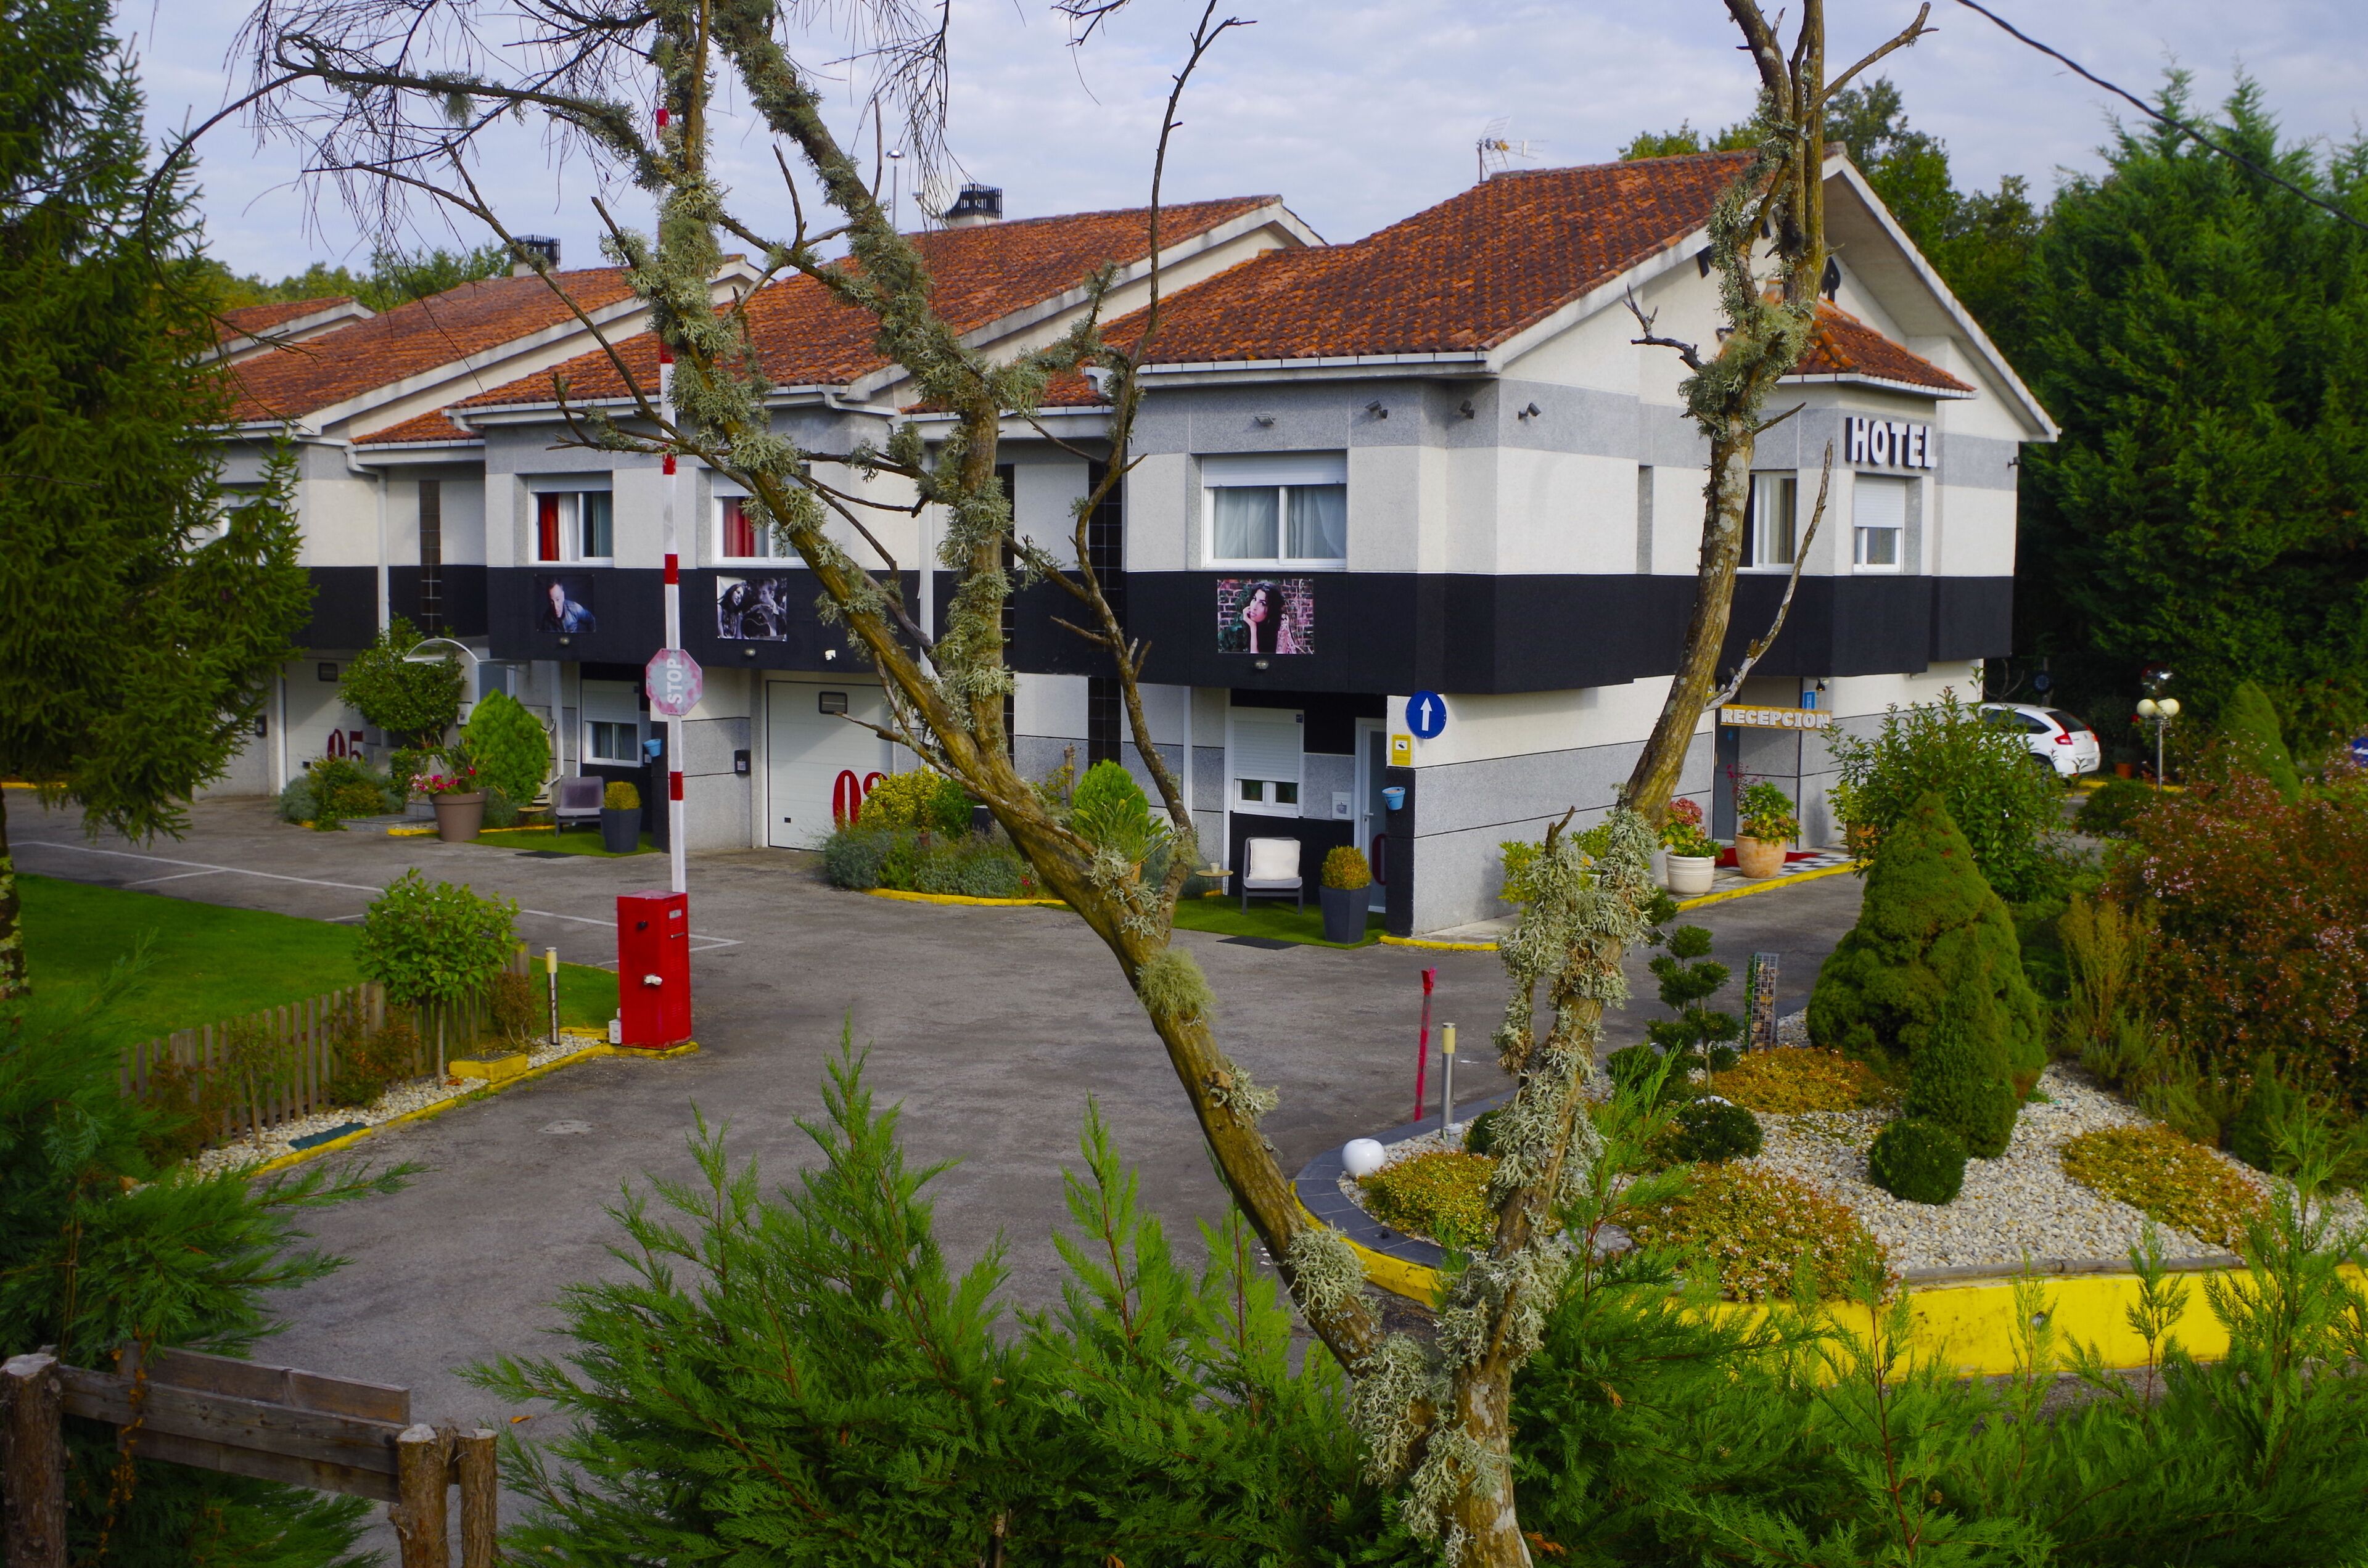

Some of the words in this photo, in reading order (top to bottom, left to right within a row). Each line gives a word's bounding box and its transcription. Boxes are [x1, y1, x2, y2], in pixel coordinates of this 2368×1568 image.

[1846, 417, 1937, 468] HOTEL
[667, 658, 683, 704] STOP
[1721, 708, 1830, 729] RECEPCION
[327, 729, 364, 763] 05
